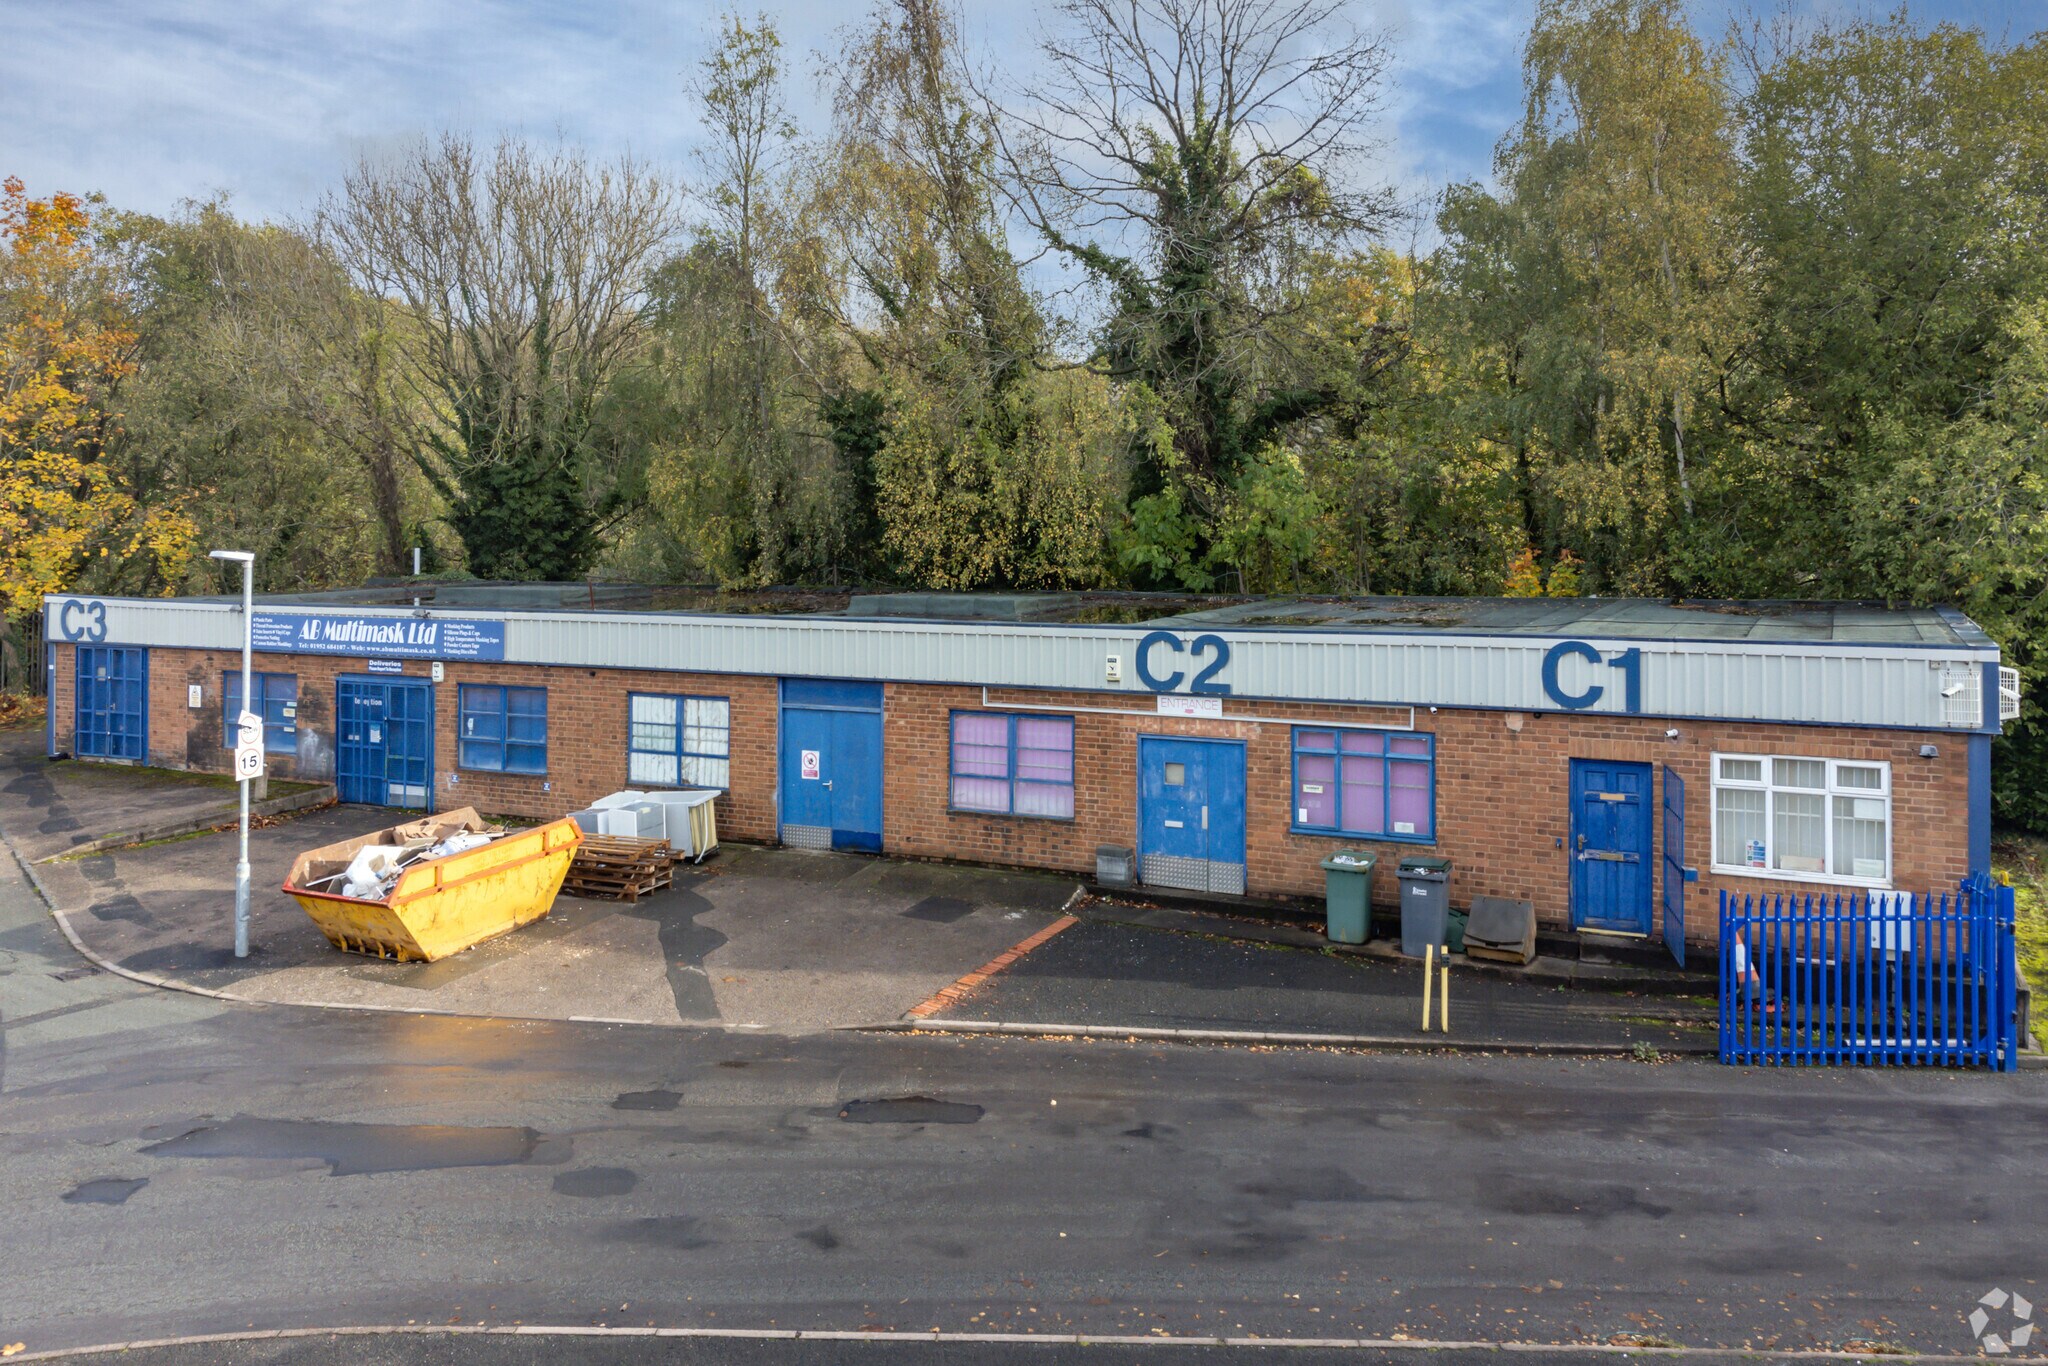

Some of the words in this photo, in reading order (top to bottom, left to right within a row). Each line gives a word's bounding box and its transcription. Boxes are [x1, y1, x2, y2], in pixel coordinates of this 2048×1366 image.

[61, 599, 107, 641] C3
[298, 619, 321, 640] AB
[322, 620, 405, 644] Multimask
[407, 622, 438, 645] Ltd
[366, 646, 437, 654] www.abmultimask.co.uk
[1136, 631, 1231, 694] C2
[1542, 641, 1641, 713] C1
[1160, 697, 1219, 711] ENTRANCE
[242, 755, 257, 770] 15
